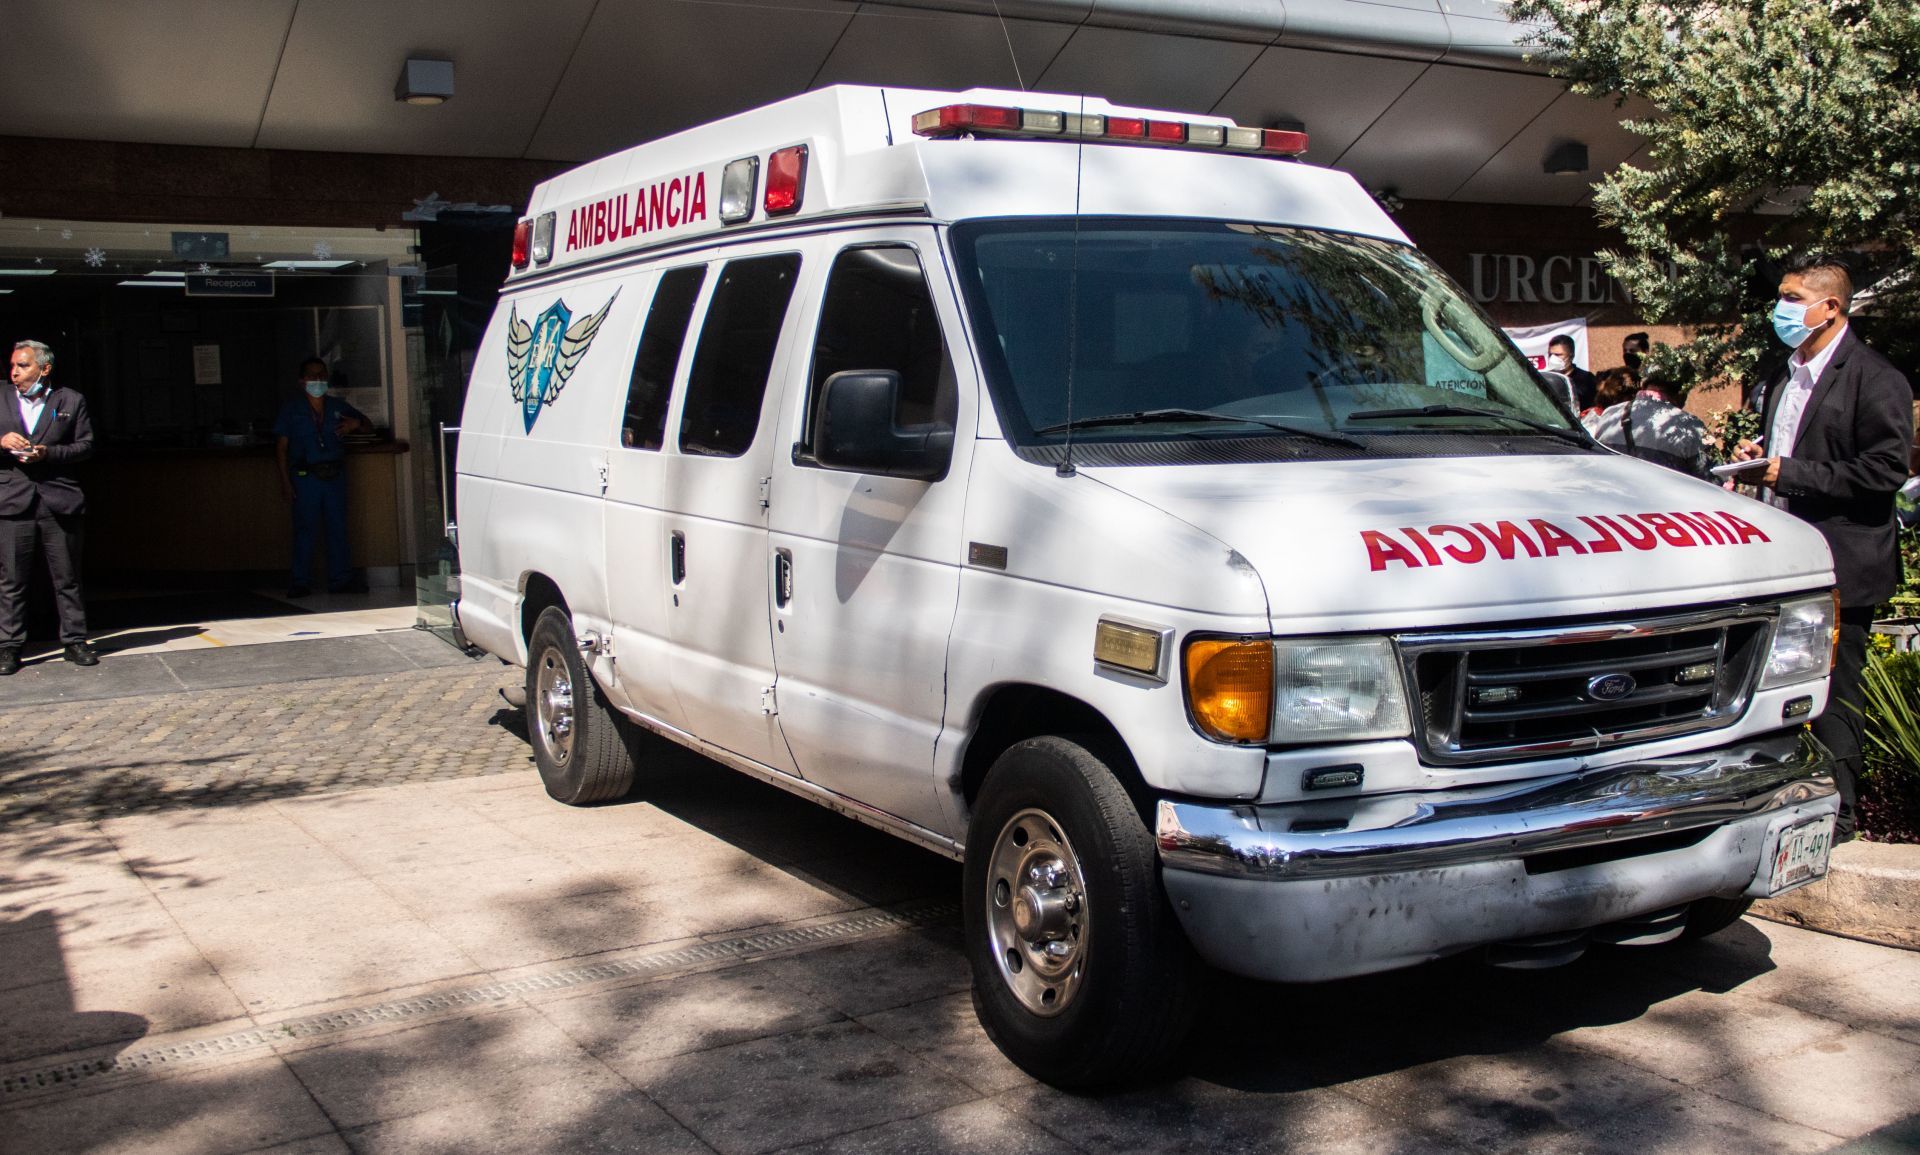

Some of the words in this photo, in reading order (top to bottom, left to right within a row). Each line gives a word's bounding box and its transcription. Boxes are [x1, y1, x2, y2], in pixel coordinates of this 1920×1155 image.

[566, 171, 706, 252] AMBULANCIA
[205, 278, 256, 288] Recepción
[1435, 378, 1486, 391] ATENCIÓN
[1602, 680, 1626, 694] Ford
